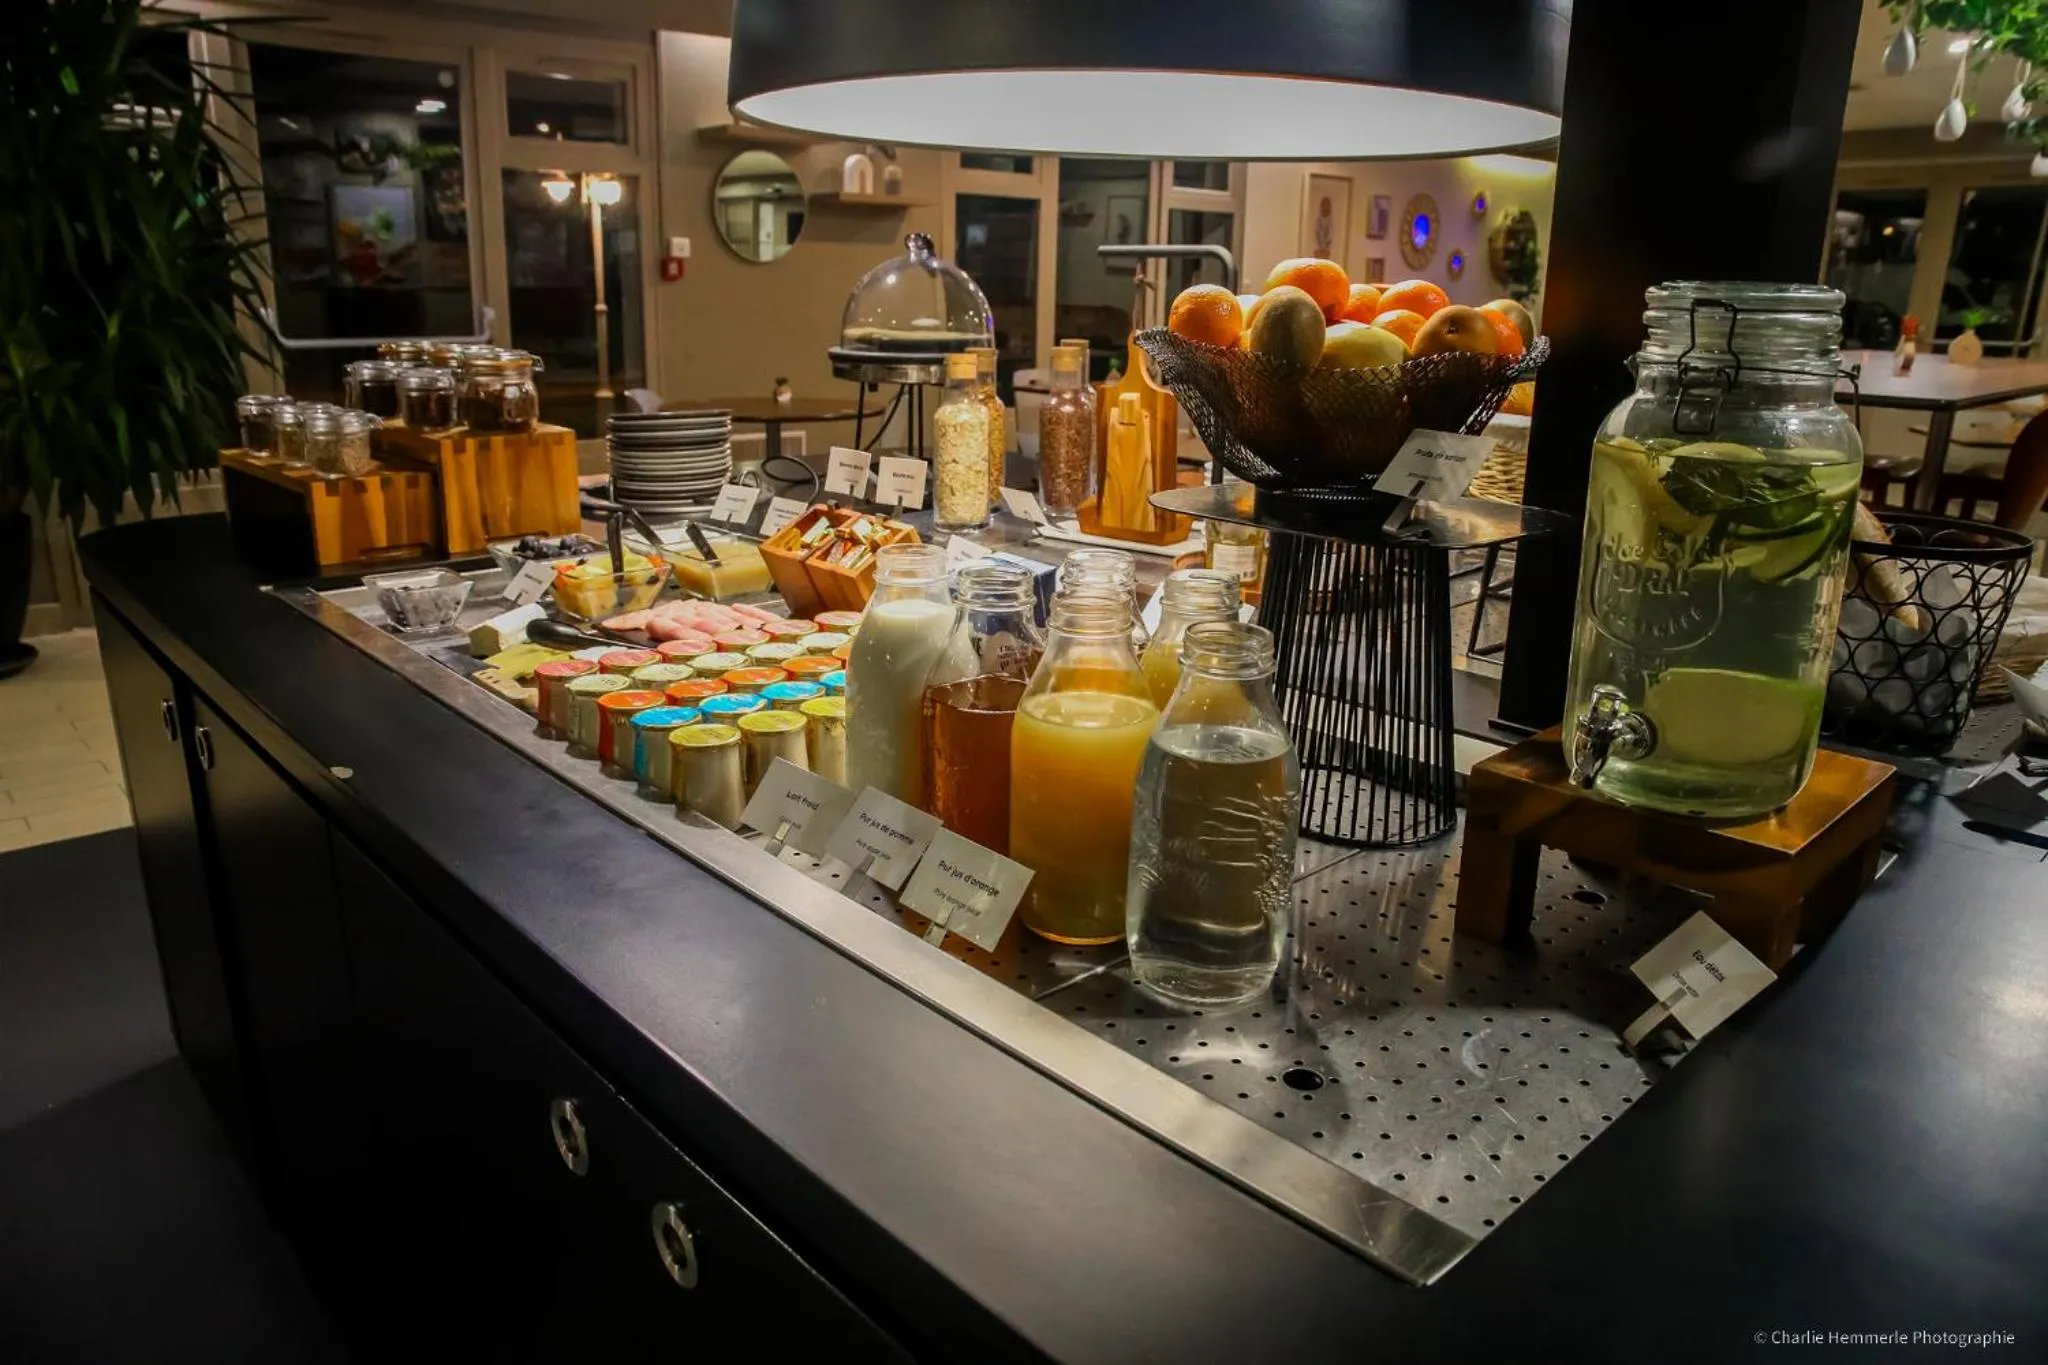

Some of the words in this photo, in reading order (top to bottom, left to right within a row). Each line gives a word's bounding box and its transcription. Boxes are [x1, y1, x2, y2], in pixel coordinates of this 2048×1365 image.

[786, 789, 802, 803] Lait
[802, 796, 821, 810] froid
[860, 812, 871, 824] Pur
[880, 824, 890, 834] de
[938, 859, 952, 872] Pur
[950, 865, 964, 879] jus
[963, 874, 1001, 898] d'orange
[1692, 948, 1706, 965] Eau
